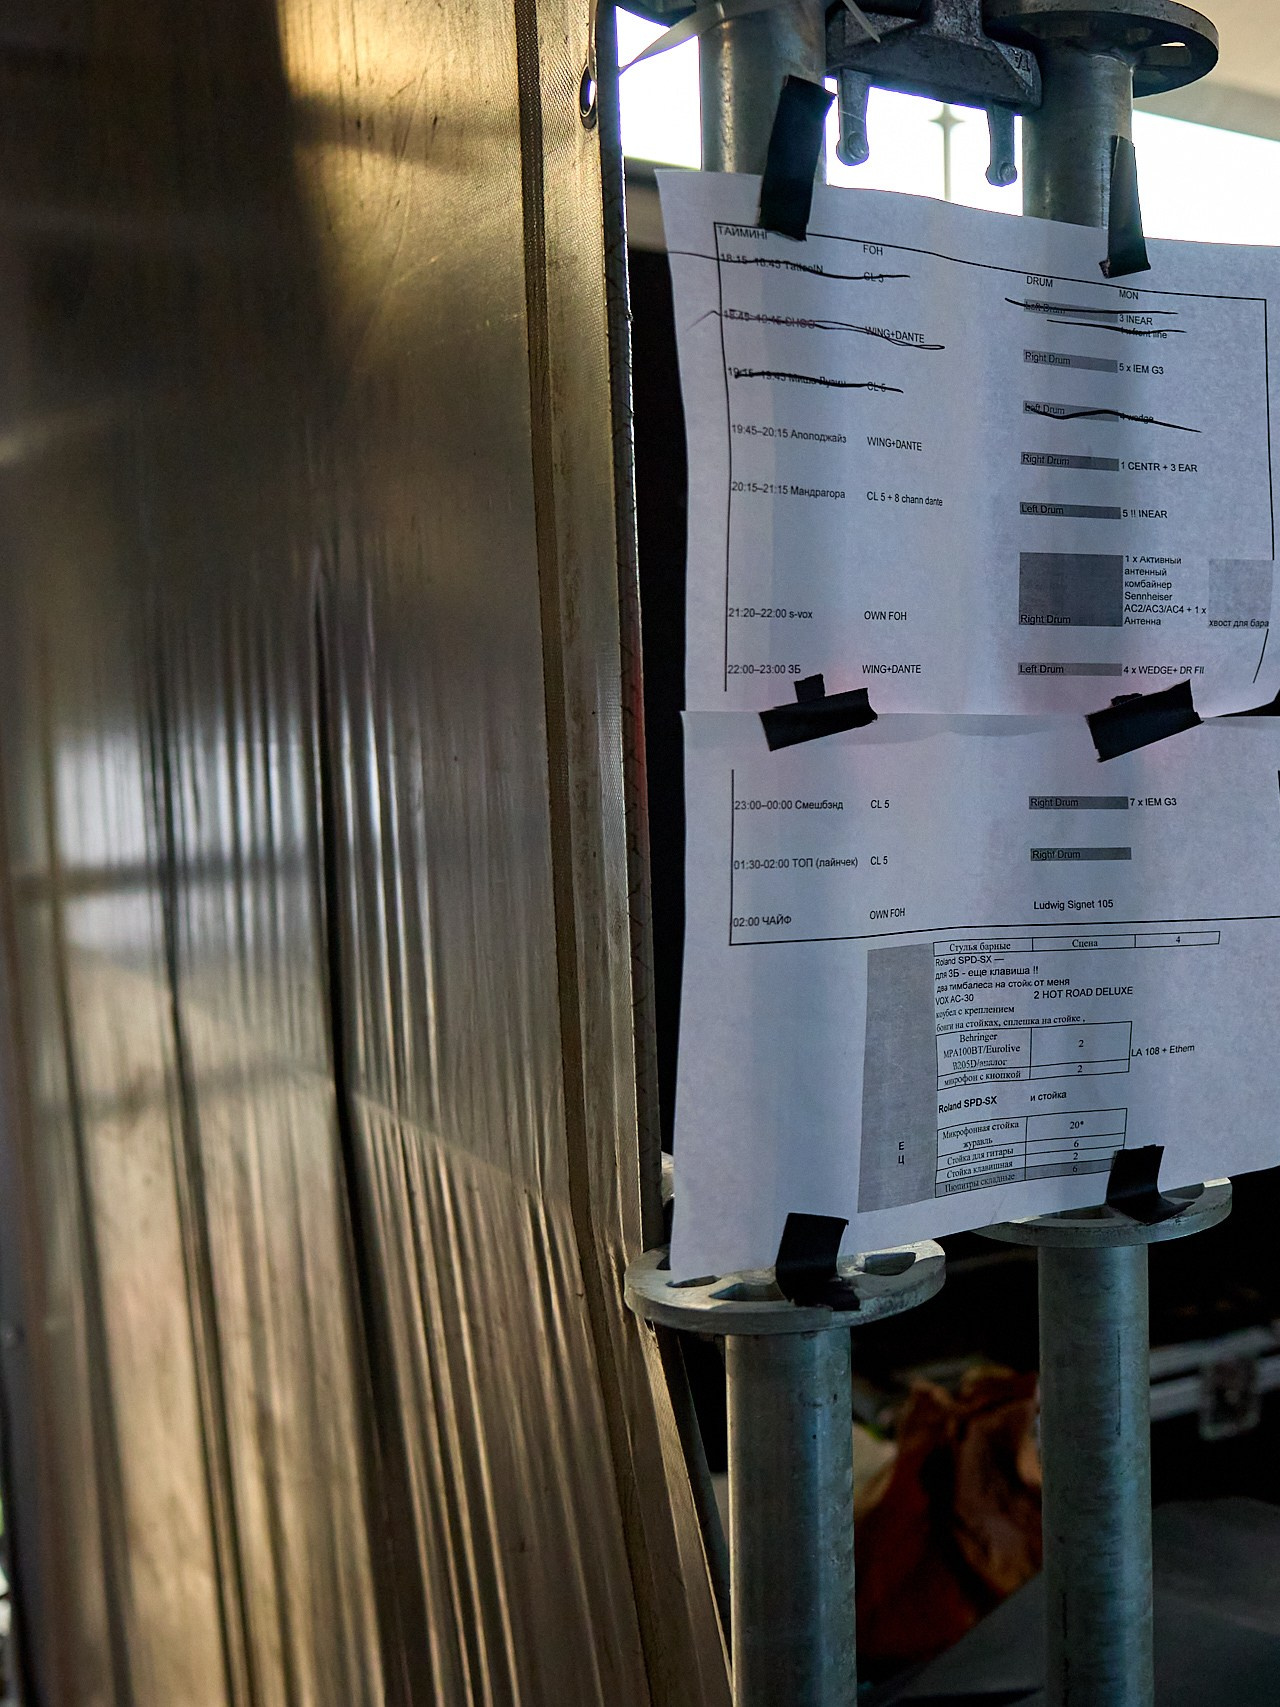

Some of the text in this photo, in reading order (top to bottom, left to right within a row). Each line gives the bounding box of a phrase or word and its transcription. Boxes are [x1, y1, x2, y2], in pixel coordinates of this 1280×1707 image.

[863, 245, 883, 256] FOH
[1026, 276, 1053, 288] DRUM
[1119, 290, 1139, 300] MON
[1119, 314, 1153, 326] 3 INEAR
[865, 326, 925, 343] WING+DANTE
[1025, 351, 1071, 365] Right Drum
[1119, 364, 1124, 372] 5
[1133, 364, 1150, 373] IEM
[1152, 365, 1164, 375] G3
[867, 381, 886, 392] CL 5
[1025, 403, 1065, 414] Left Drum
[867, 437, 922, 451] WING+DANTE
[1022, 454, 1070, 466] Right Drum
[1121, 461, 1125, 470] 1
[1128, 462, 1160, 471] CENTR
[1170, 463, 1176, 472] 3
[1178, 463, 1198, 473] EAR
[790, 485, 845, 500] Мандрагора
[867, 492, 879, 501] CL
[880, 493, 886, 501] 5
[894, 494, 900, 502] 8
[901, 494, 923, 505] chann
[925, 496, 943, 506] dante
[1021, 504, 1064, 515] Left Drum
[1122, 509, 1168, 519] 5 !! INEAR
[1125, 555, 1129, 563] 1
[1139, 555, 1182, 565] Активный
[1124, 567, 1167, 577] антенный
[1124, 579, 1172, 591] комбайнер
[1124, 591, 1173, 601] Sennheiser
[789, 610, 813, 619] s-vox
[1124, 604, 1185, 614] AC2/AC3/AC4
[864, 611, 907, 621] OWN FOH
[1020, 614, 1071, 626] Right Drum
[1124, 616, 1161, 626] Антенна
[1209, 618, 1270, 629] хвост для бара
[862, 664, 921, 674] WING+DANTE
[1019, 664, 1064, 674] Left Drum
[1123, 666, 1129, 674] 4
[1138, 666, 1178, 675] WEDGE+
[1180, 666, 1192, 675] DR
[795, 800, 844, 812] Смешбэнд
[870, 800, 890, 809] CL 5
[1030, 798, 1079, 808] Right Drum
[1130, 798, 1135, 806] 7
[1145, 798, 1162, 806] IEM
[1164, 798, 1177, 806] G3
[870, 856, 888, 866] CL 5
[1032, 850, 1081, 861] Right Drum
[793, 858, 813, 868] ТОП
[815, 857, 859, 870] (лайнчек)
[1033, 899, 1114, 912] Ludwig Signet 105
[869, 907, 905, 920] OWN FOH
[733, 914, 792, 927] 02:00 ЧАЙФ
[949, 943, 978, 954] Стулья
[979, 942, 1011, 953] барные
[1072, 939, 1098, 948] Сцена
[936, 955, 992, 967] Roland SPD-SX
[935, 966, 1039, 981] для еще клавиша !!
[936, 984, 948, 994] два
[949, 980, 993, 991] тимбалеса
[1046, 978, 1070, 986] меня
[1034, 986, 1133, 999] 2 HOT ROAD DELUXE
[935, 993, 974, 1006] VOX AC-30
[964, 1006, 1015, 1016] креплением
[955, 1021, 964, 1029] на
[966, 1019, 1001, 1029] стойках,
[1003, 1017, 1040, 1026] сплешка
[1053, 1015, 1081, 1024] стойке
[959, 1033, 998, 1043] Behringer
[1131, 1047, 1160, 1057] LA 108
[986, 1071, 1021, 1080] кнопкой
[1077, 1065, 1083, 1073] 2
[1038, 1091, 1067, 1101] стойка
[938, 1096, 998, 1113] Roland SPD-SX
[942, 1123, 990, 1140] Микрофонная
[992, 1120, 1019, 1130] стойка
[963, 1137, 993, 1151] журавль
[947, 1154, 971, 1165] Стойка
[986, 1148, 1014, 1159] гитары
[946, 1168, 972, 1179] Стойка
[973, 1161, 1013, 1174] клавишная
[945, 1173, 1015, 1193] Пюпитры складные
